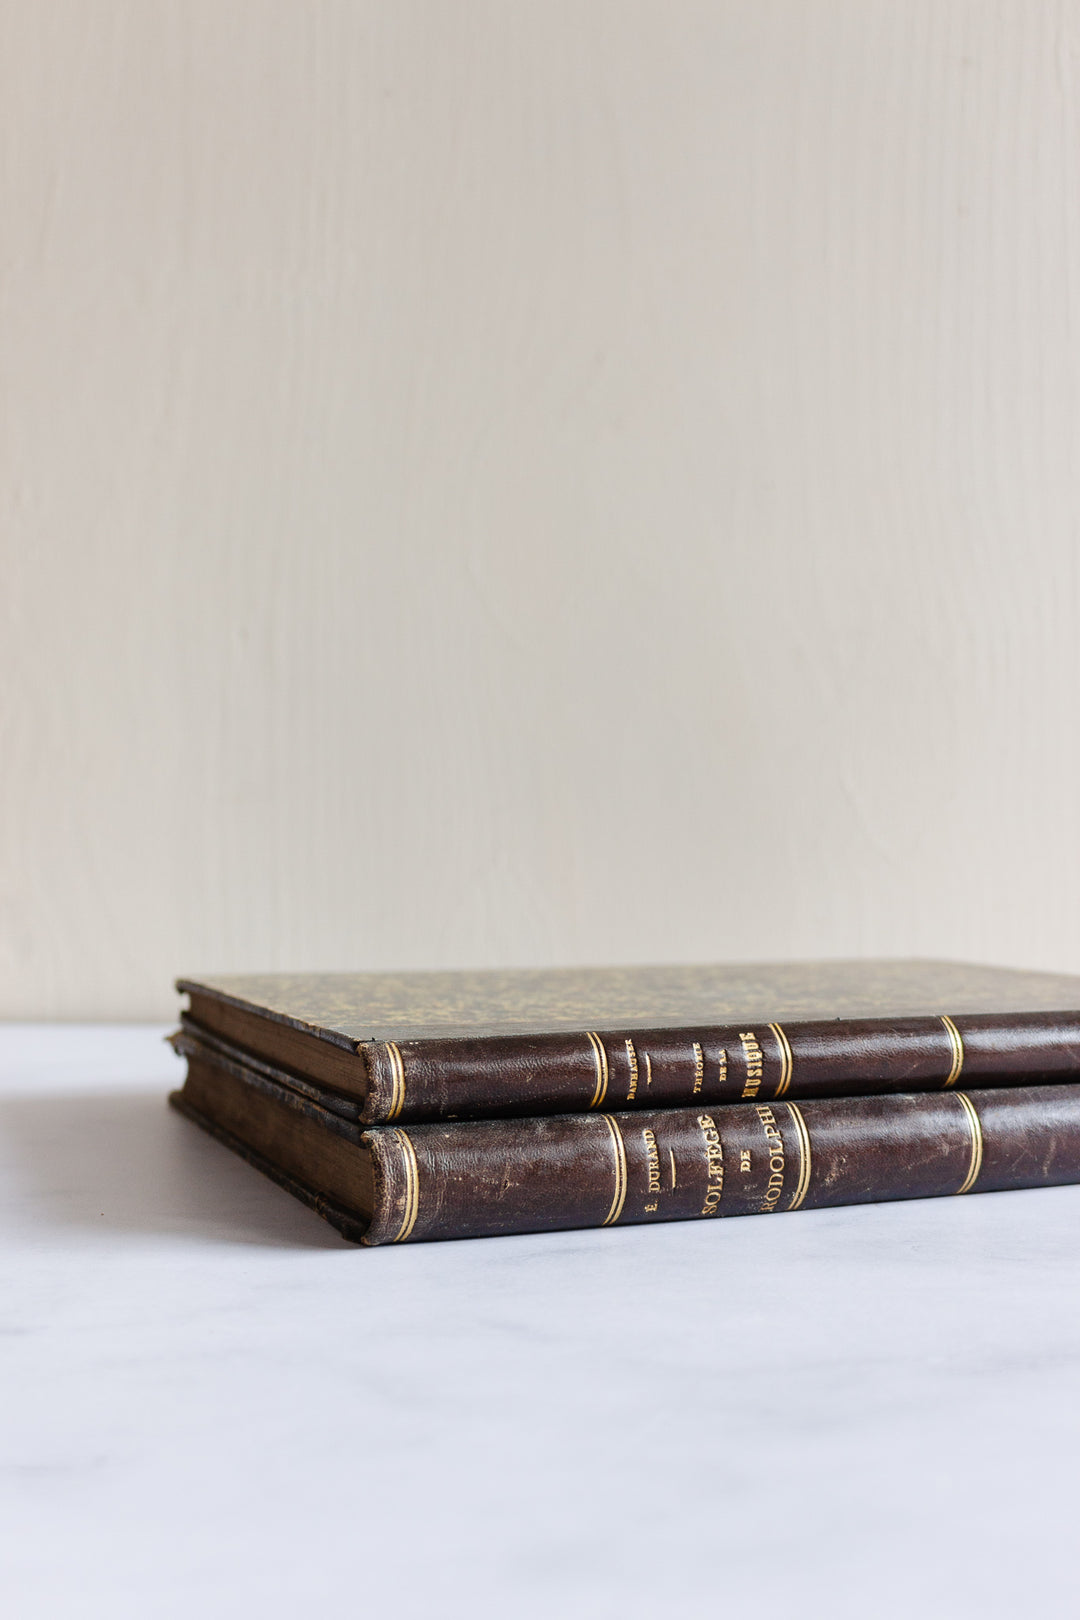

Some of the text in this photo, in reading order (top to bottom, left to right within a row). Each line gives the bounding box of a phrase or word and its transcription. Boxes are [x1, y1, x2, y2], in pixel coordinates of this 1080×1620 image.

[692, 1042, 704, 1094] THÉORIE
[718, 1049, 728, 1082] DE LA
[739, 1032, 763, 1098] MUSIQUE
[642, 1129, 660, 1193] DURAND
[697, 1114, 724, 1215] SOLFÈGE
[740, 1150, 751, 1173] DE
